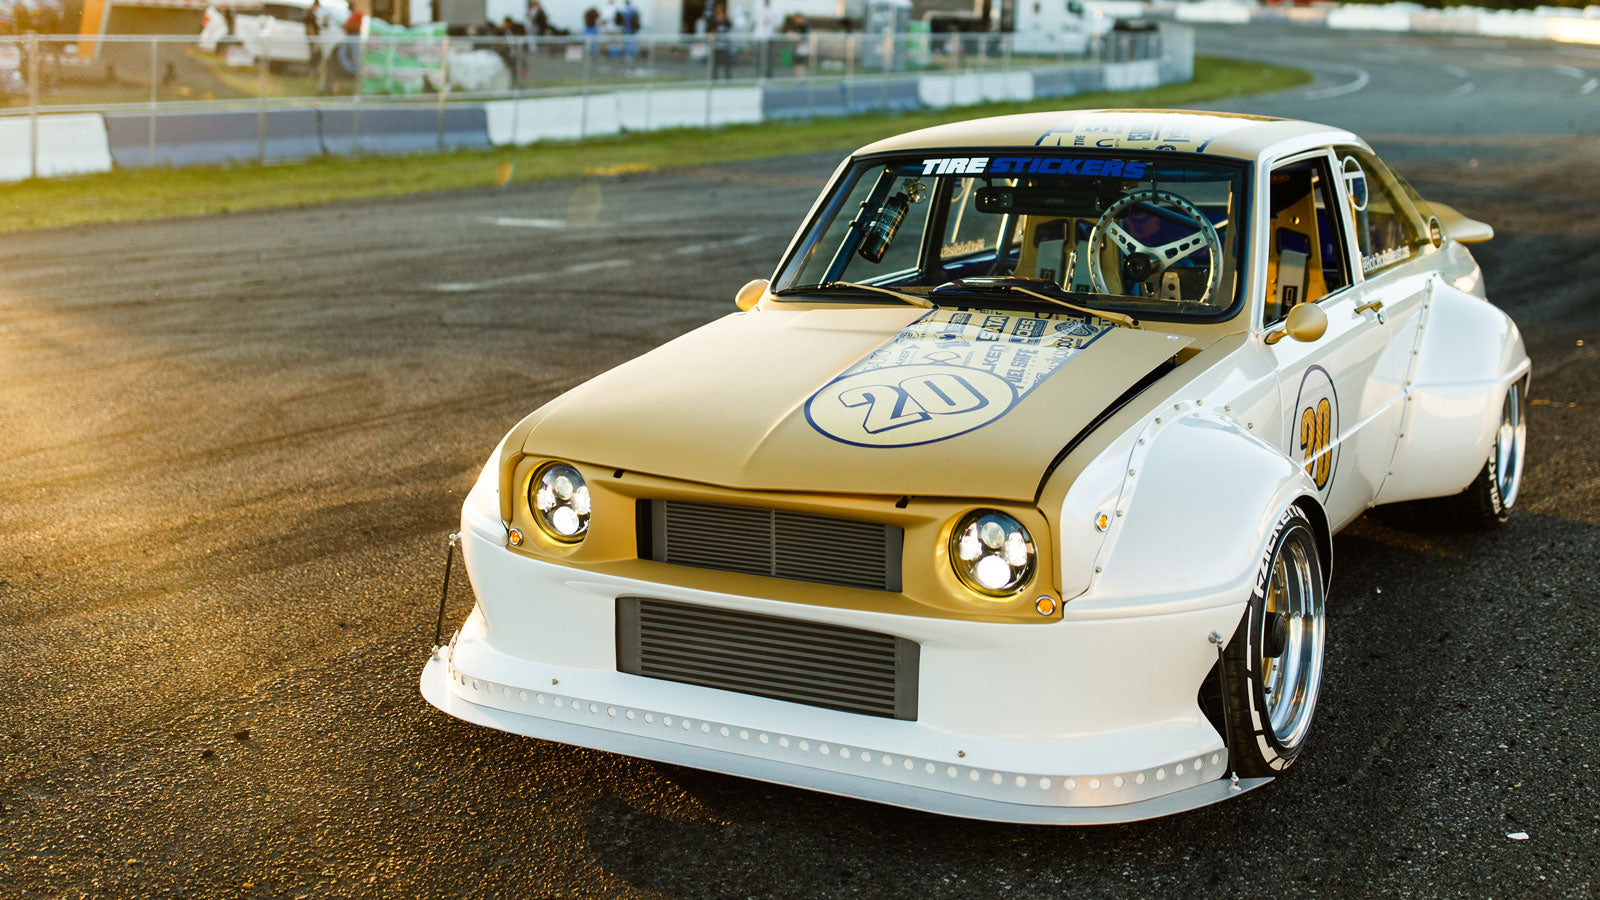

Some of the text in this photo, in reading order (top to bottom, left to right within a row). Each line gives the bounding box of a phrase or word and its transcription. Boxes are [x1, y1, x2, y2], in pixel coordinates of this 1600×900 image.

[922, 157, 1148, 179] TIRE STICKERS
[837, 373, 990, 434] 20
[1301, 397, 1332, 491] 20
